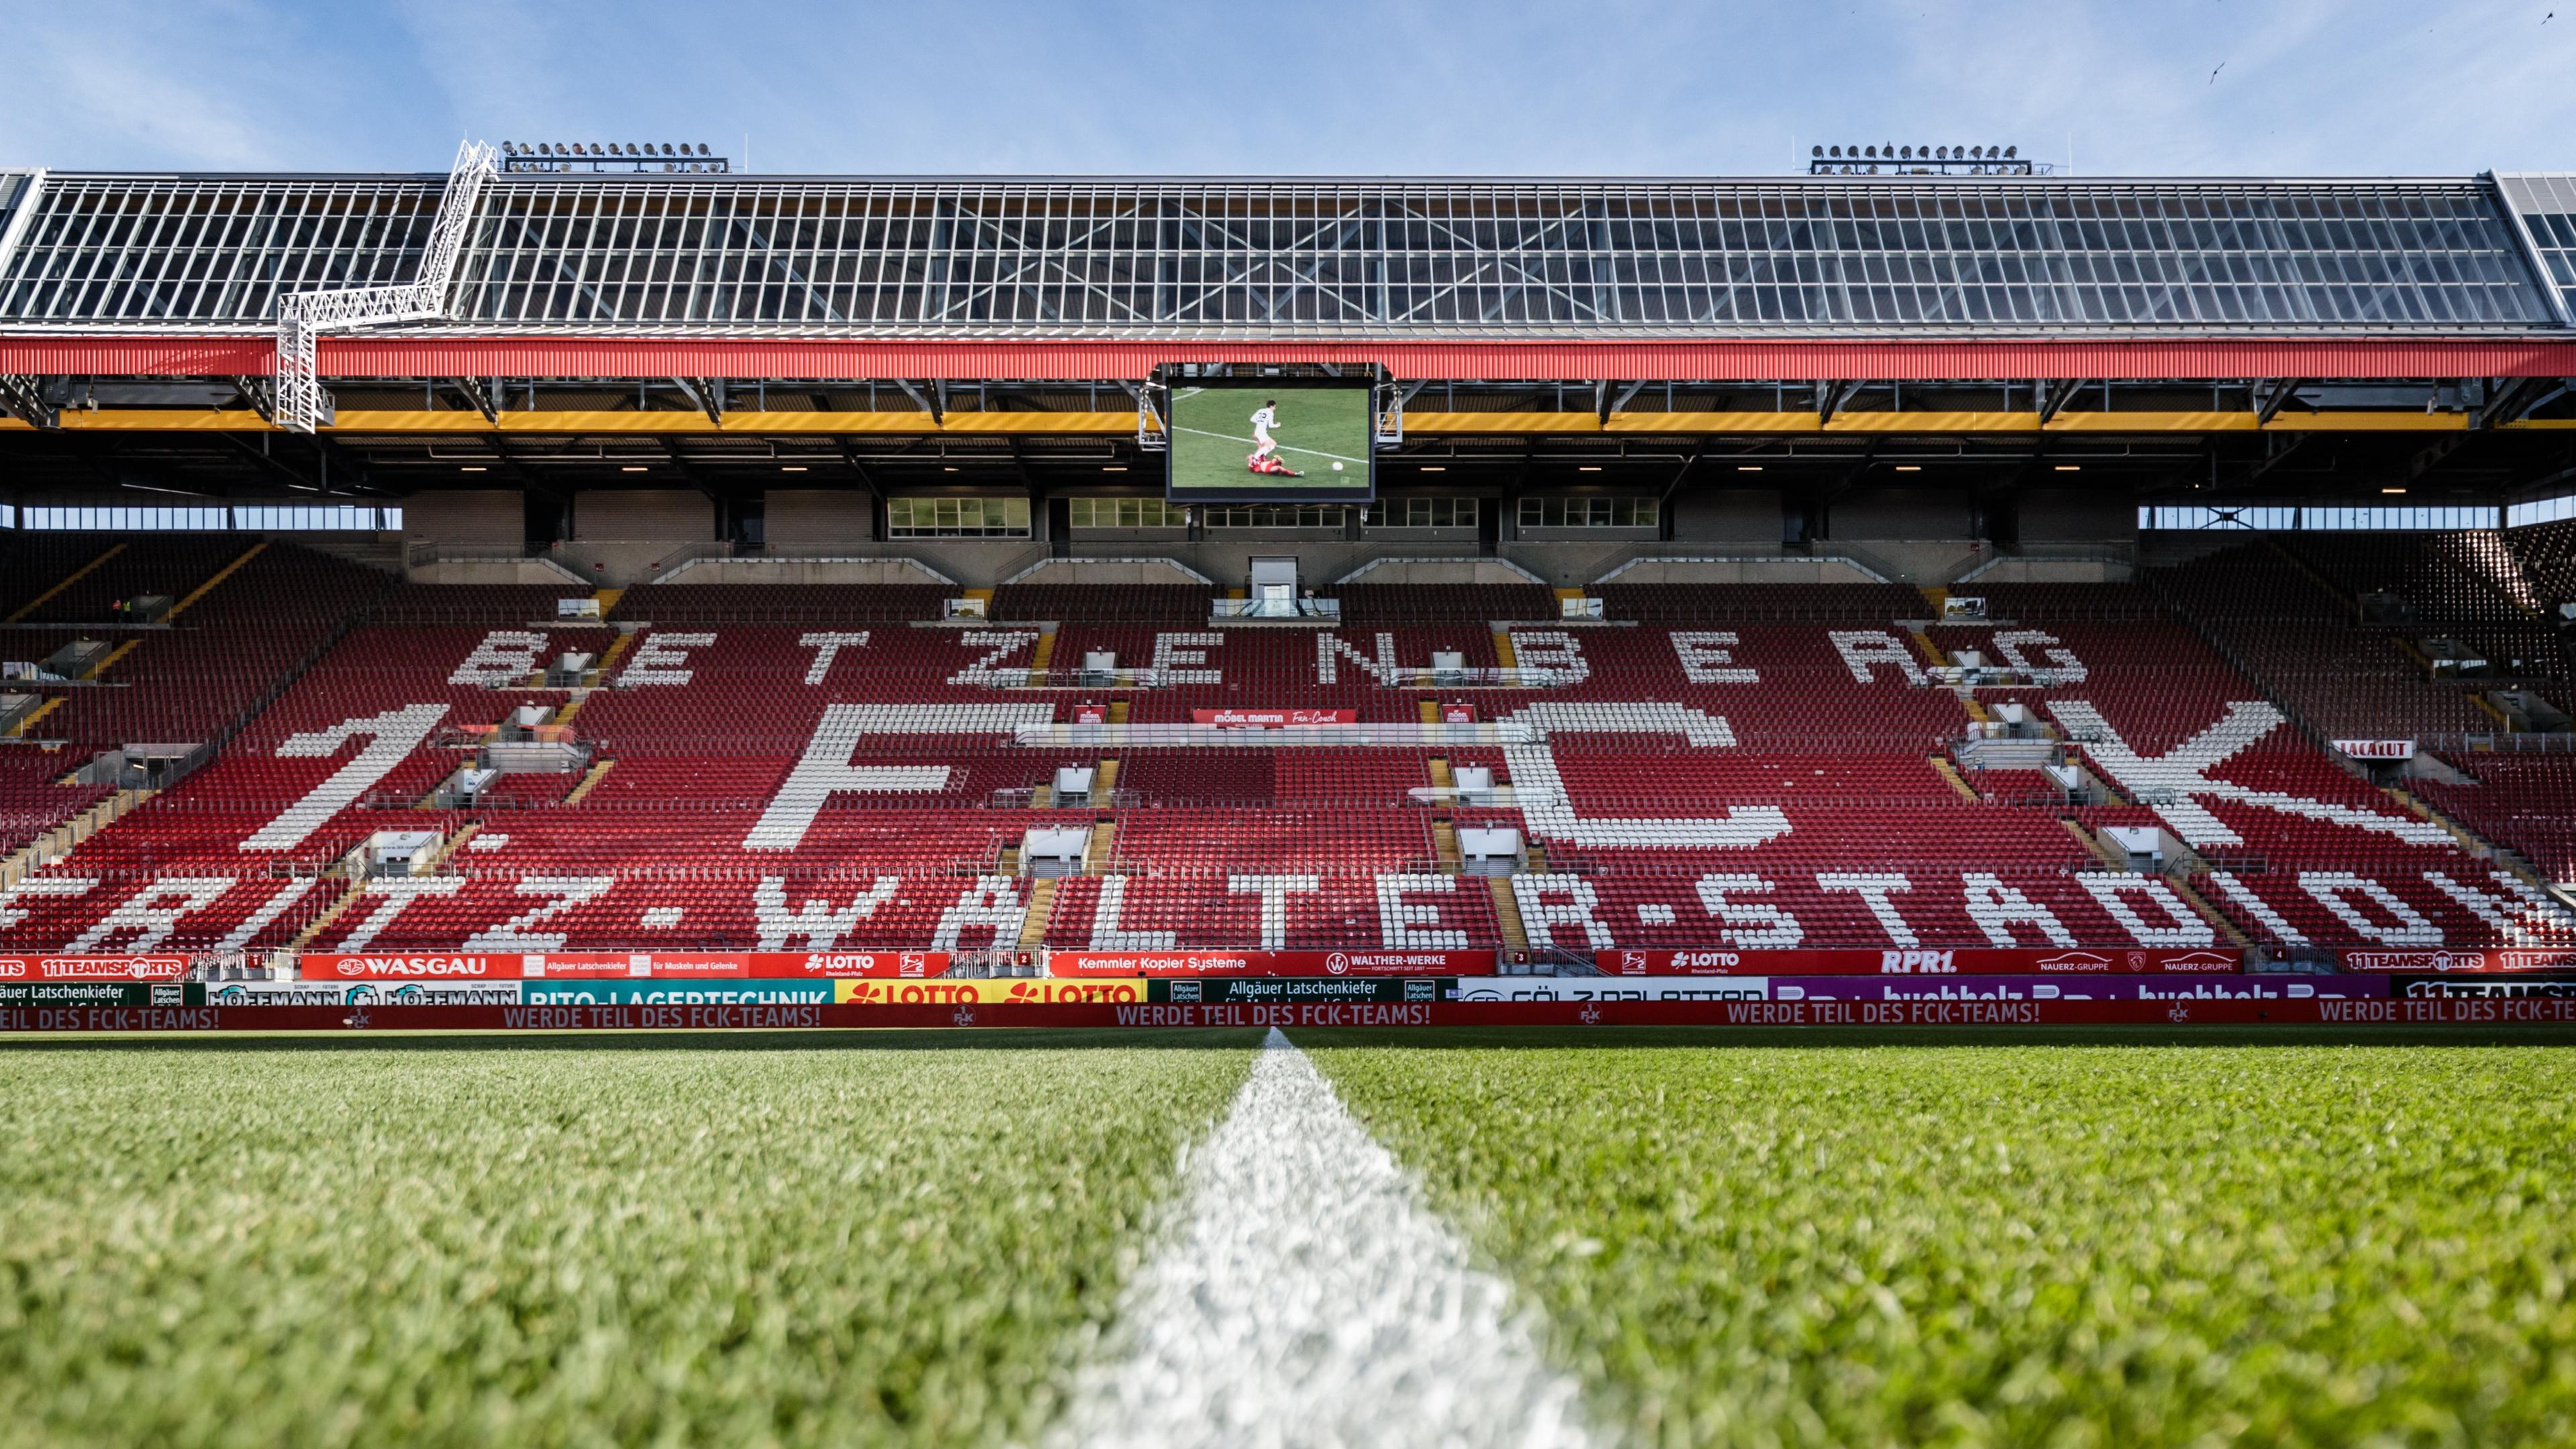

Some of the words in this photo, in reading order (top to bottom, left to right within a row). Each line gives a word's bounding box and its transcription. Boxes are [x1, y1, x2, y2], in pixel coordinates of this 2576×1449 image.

[448, 630, 2088, 686] BETZENBERG
[1214, 710, 1246, 722] MÖBEL
[1248, 714, 1283, 722] MARTIN
[826, 955, 874, 969] LOTTO
[1021, 955, 1027, 963] 2
[1351, 955, 1446, 965] WALTHER-WERKE
[1518, 953, 1524, 961] 3
[1691, 953, 1739, 967] LOTTO
[364, 957, 486, 975] WASGAU
[547, 961, 577, 971] Allgäuer
[578, 961, 627, 970] Latschenkiefer
[653, 961, 664, 970] für
[665, 961, 694, 970] Muskeln
[695, 961, 708, 970] und
[710, 961, 738, 970] Gelenke
[1077, 957, 1137, 970] Kemmler
[1140, 957, 1185, 971] Kopier
[1188, 957, 1246, 971] Systeme
[1638, 960, 1646, 969] 2
[2041, 962, 2109, 971] NAUERZ-GRUPPE
[2165, 963, 2233, 971] NAUERZ-GRUPPE
[32, 984, 123, 999] Latschenkiefer
[154, 988, 180, 997] Allgäuer
[1173, 984, 1199, 994] Allgäuer
[1230, 981, 1282, 997] Allgäuer
[1286, 981, 1377, 994] Latschenkiefer
[1407, 983, 1433, 991] Allgäuer
[886, 985, 979, 1004] LOTTO
[1044, 985, 1136, 1003] LOTTO
[1173, 992, 1199, 1001] Latschen
[1407, 991, 1433, 999] Latschen
[154, 996, 180, 1005] Latschen
[1116, 1006, 1194, 1025] WERDE
[1201, 1006, 1245, 1025] TEIL
[1253, 1005, 1294, 1025] DES
[1302, 1005, 1431, 1025] FCK-TEAMS!
[1727, 1003, 1805, 1023] WERDE
[1812, 1003, 1856, 1023] TEIL
[1864, 1003, 1904, 1023] DES
[1911, 1002, 2040, 1023] FCK-TEAMS!
[2319, 1001, 2398, 1021] WERDE
[2404, 1001, 2448, 1021] TEIL
[2455, 1000, 2496, 1021] DES
[2504, 1000, 2576, 1021] FCK-TE
[40, 1008, 80, 1029] DES
[88, 1008, 219, 1029] FCK-TEAMS!
[503, 1008, 582, 1028] WERDE
[589, 1008, 634, 1028] TEIL
[641, 1007, 683, 1028] DES
[691, 1007, 820, 1027] FCK-TEAMS!
